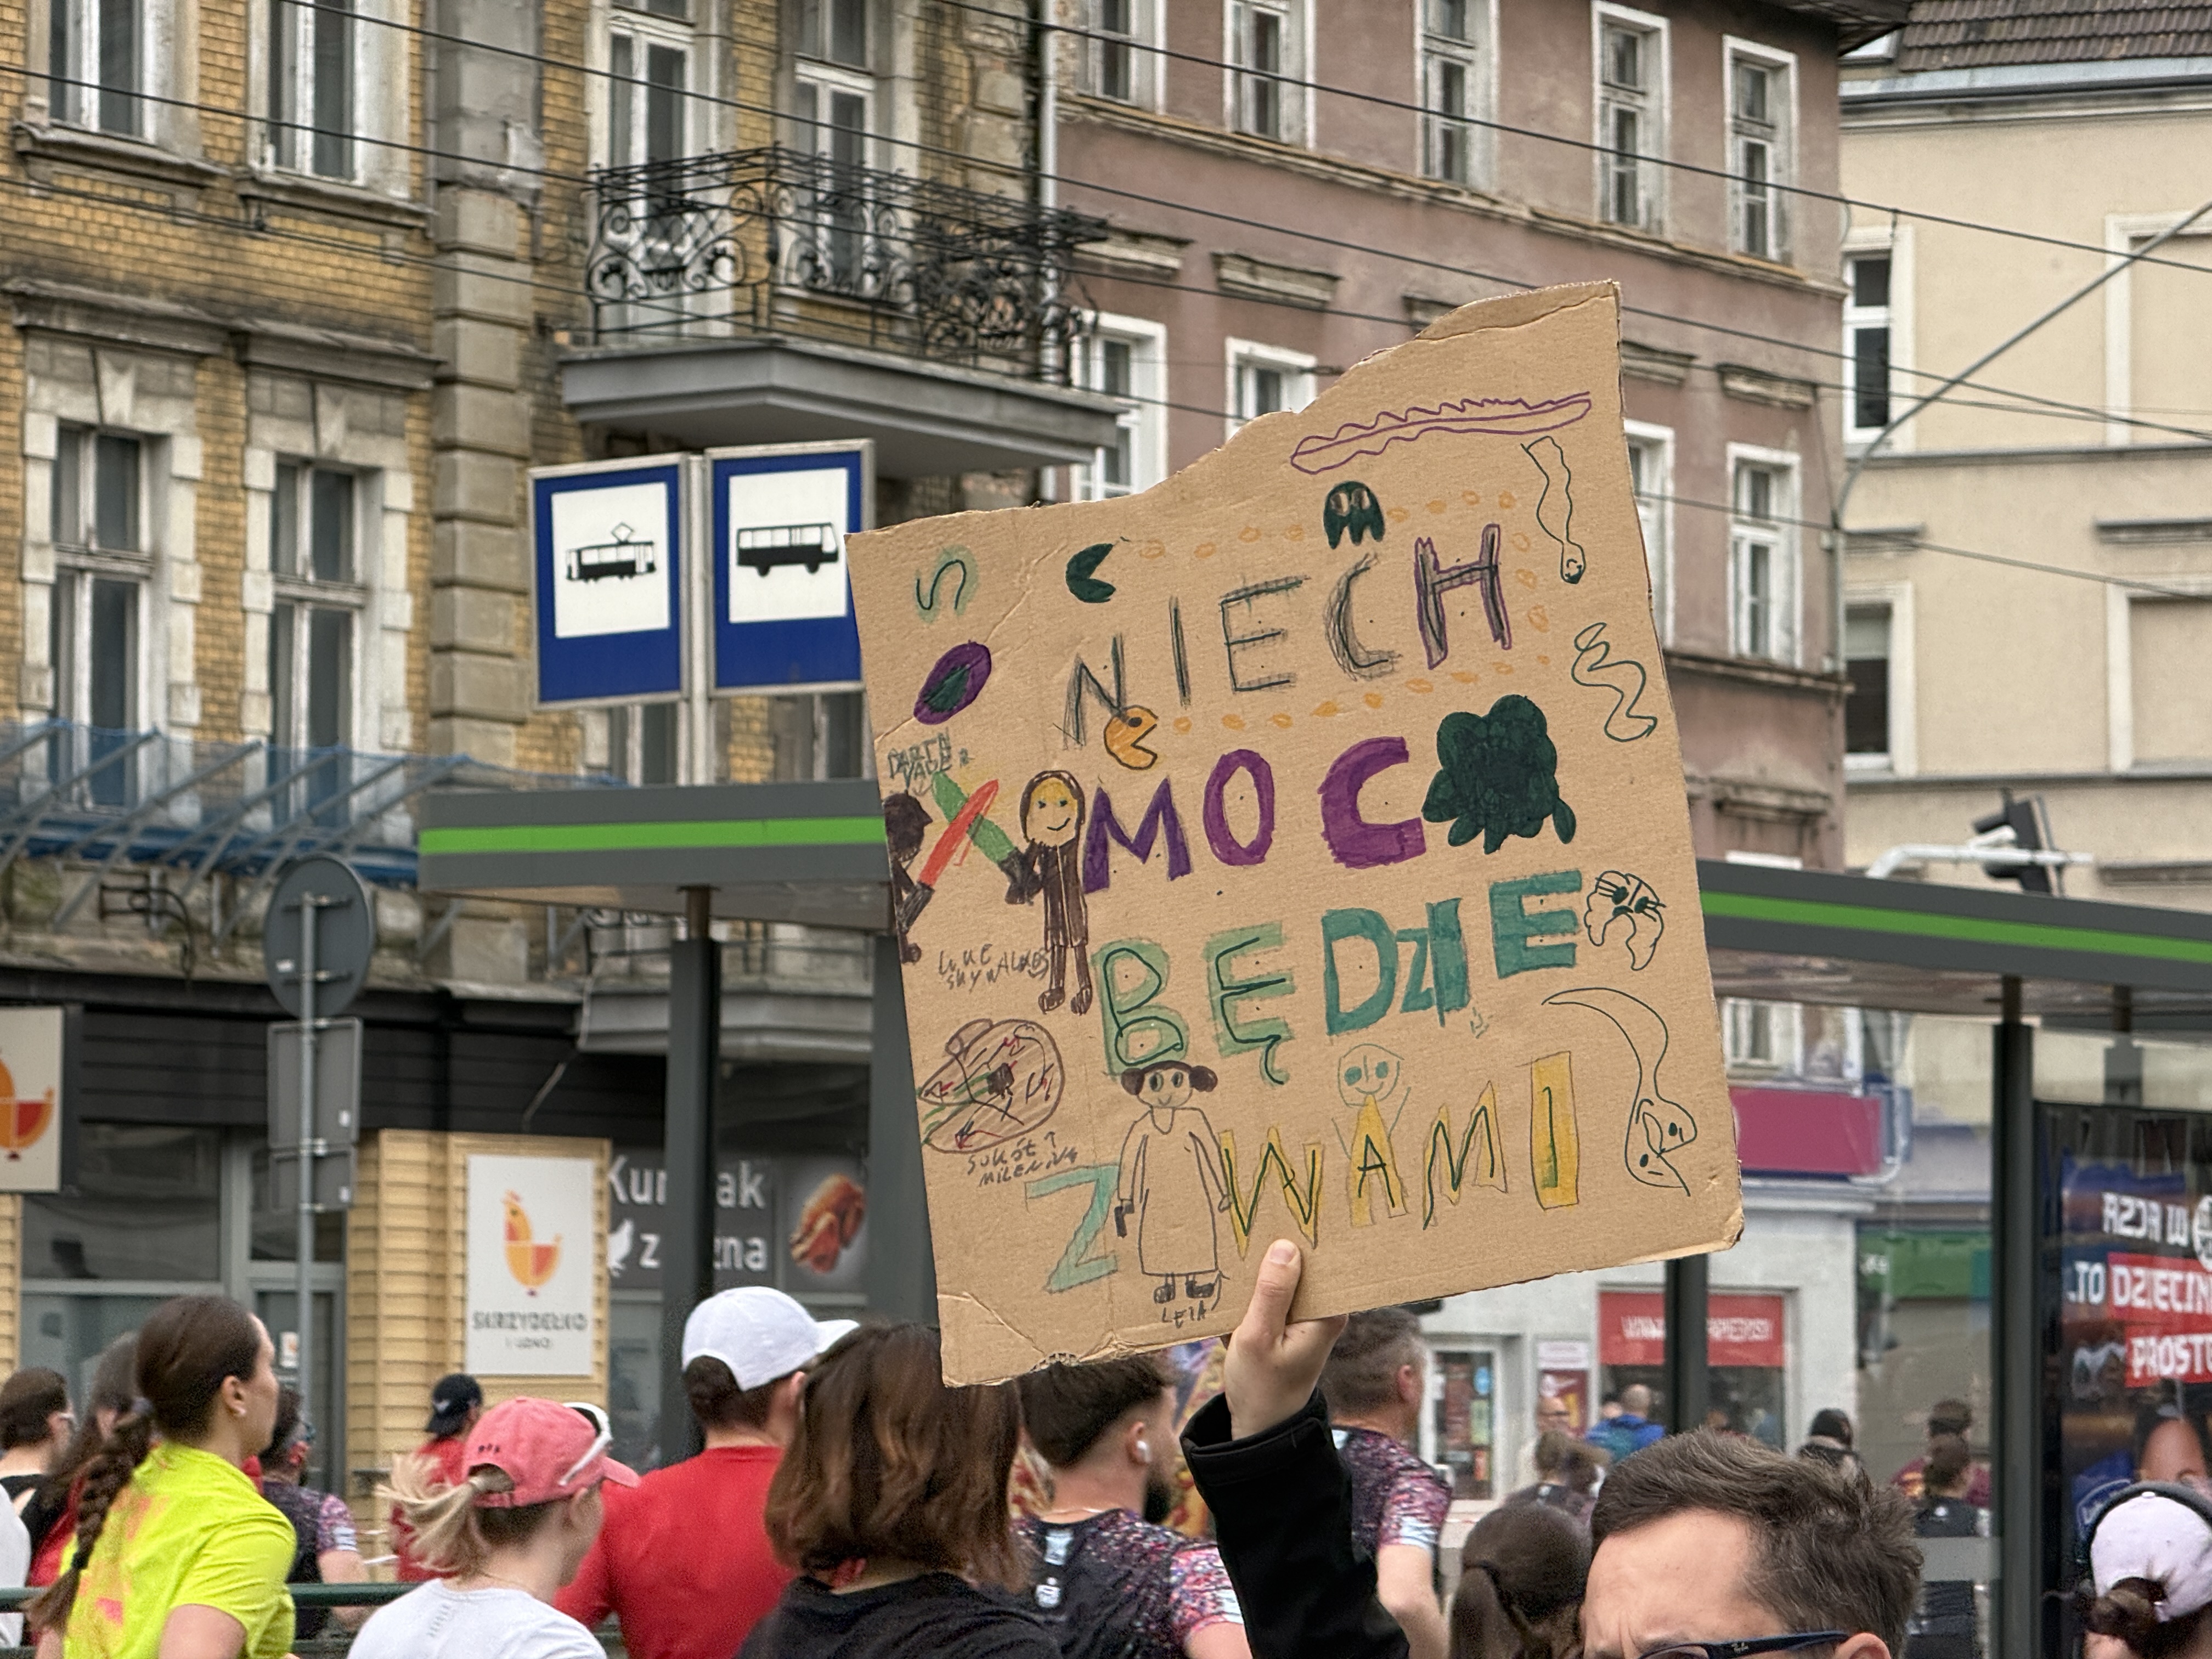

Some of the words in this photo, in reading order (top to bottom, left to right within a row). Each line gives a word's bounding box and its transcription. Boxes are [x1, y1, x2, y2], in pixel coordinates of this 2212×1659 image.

[1062, 523, 1513, 750] NIECH
[1082, 735, 1426, 894] MOC
[1091, 870, 1583, 1085] BĘDZIE
[1218, 1050, 1580, 1262] WAMI
